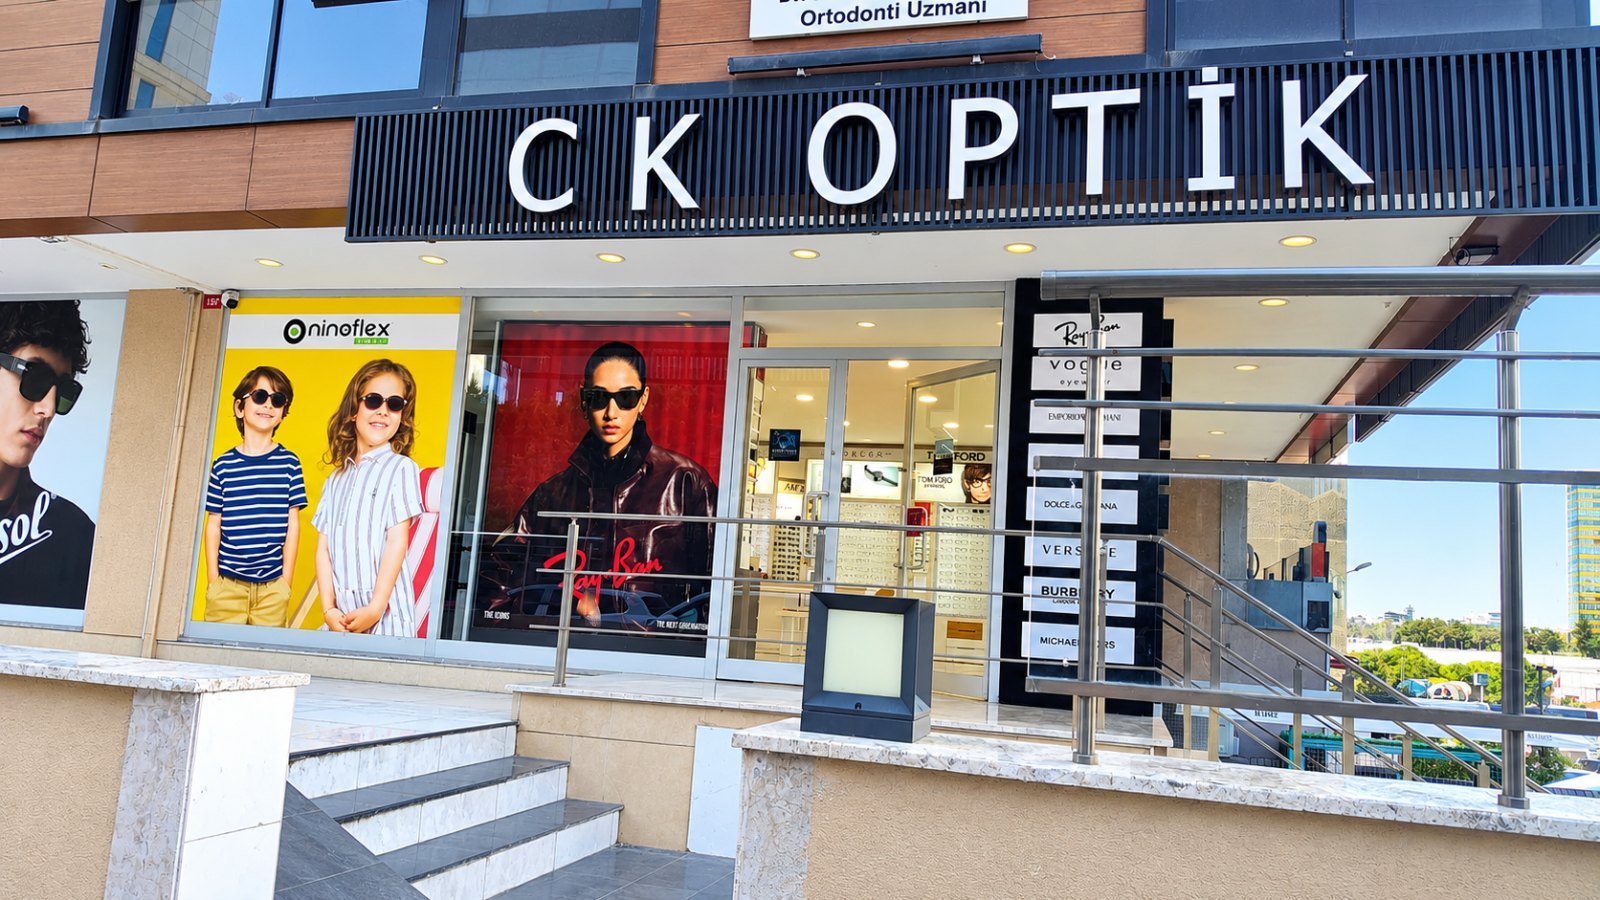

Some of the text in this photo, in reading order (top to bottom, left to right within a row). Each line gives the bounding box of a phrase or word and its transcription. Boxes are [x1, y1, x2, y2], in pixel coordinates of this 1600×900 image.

[800, 2, 900, 27] Ortodonti
[508, 66, 1375, 213] CK OPTİK
[308, 318, 391, 337] ninoflex
[954, 451, 986, 461] FORD
